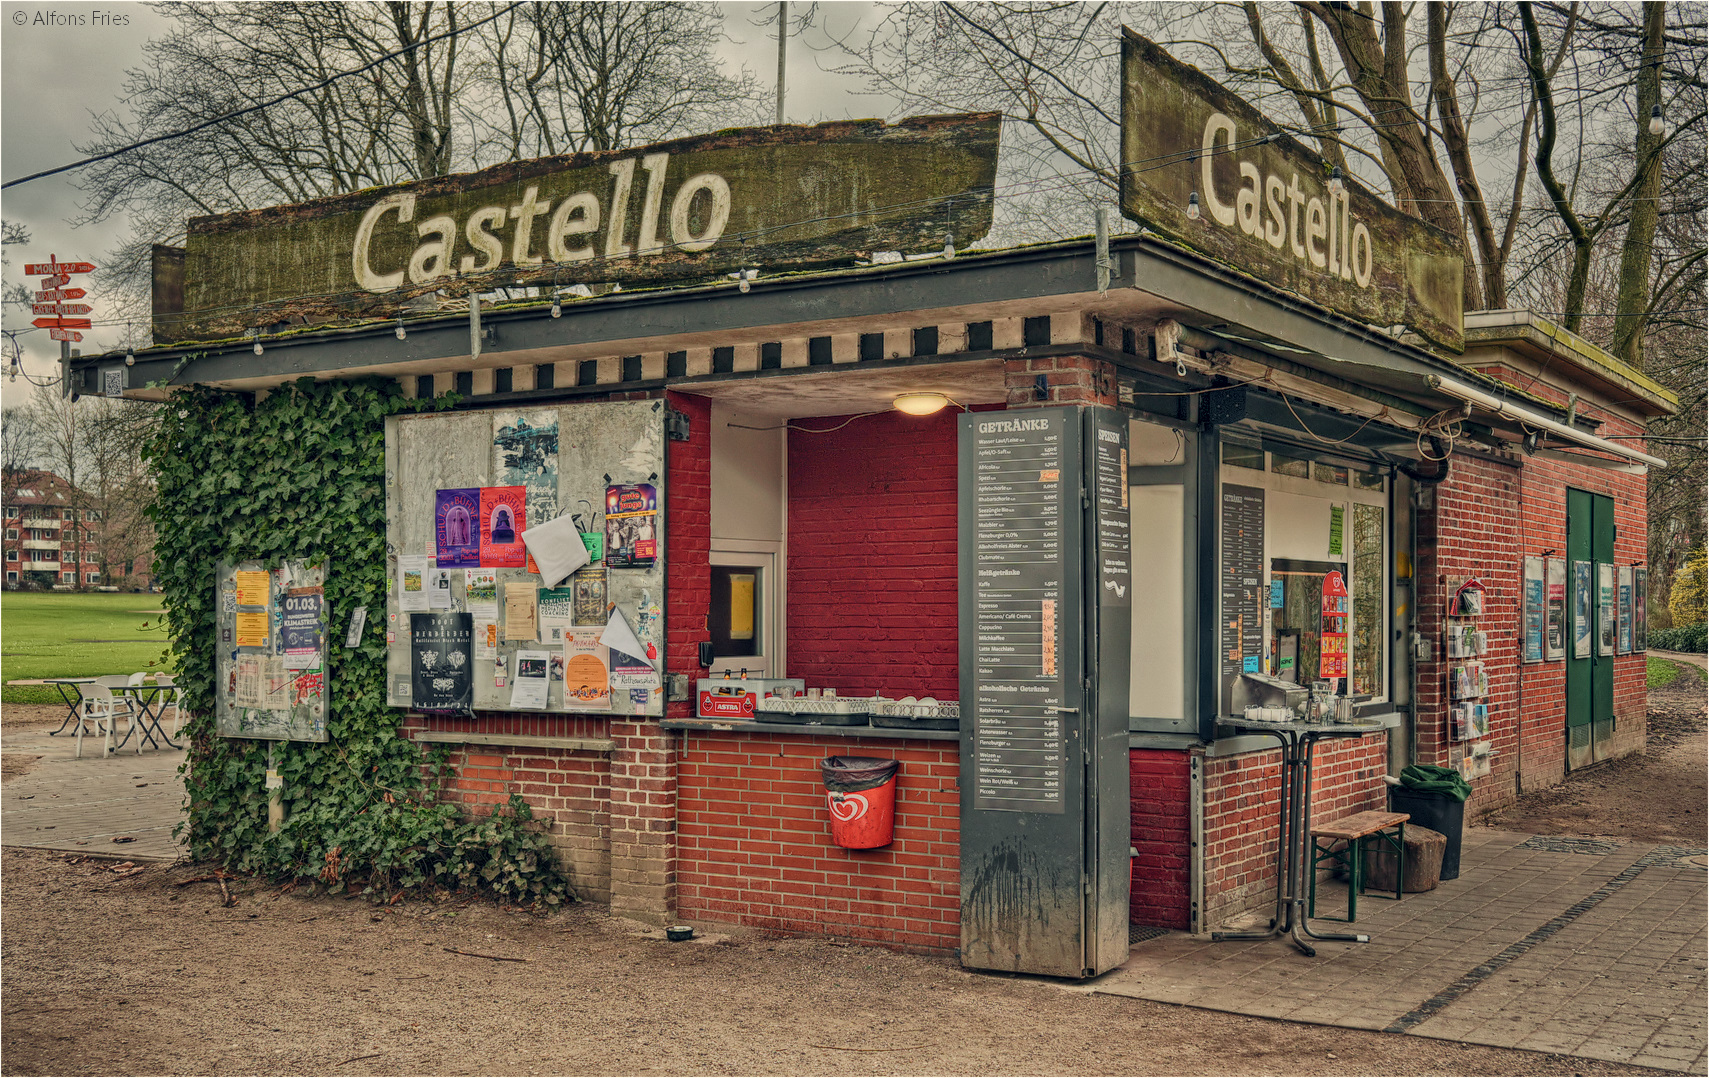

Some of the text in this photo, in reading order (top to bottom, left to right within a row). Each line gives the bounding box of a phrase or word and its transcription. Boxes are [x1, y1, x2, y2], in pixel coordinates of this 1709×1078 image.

[1201, 112, 1373, 289] Castello
[352, 152, 731, 293] Castello
[978, 418, 1050, 434] GETRÄNKE
[1098, 429, 1120, 444] SPEISEN
[621, 493, 640, 502] gute
[620, 502, 642, 510] jungs
[438, 503, 450, 547] SCHULD
[454, 496, 478, 520] BÜHNE
[483, 501, 494, 546] SCHULD
[498, 493, 522, 519] BÜHNE
[286, 598, 317, 610] 01.03.
